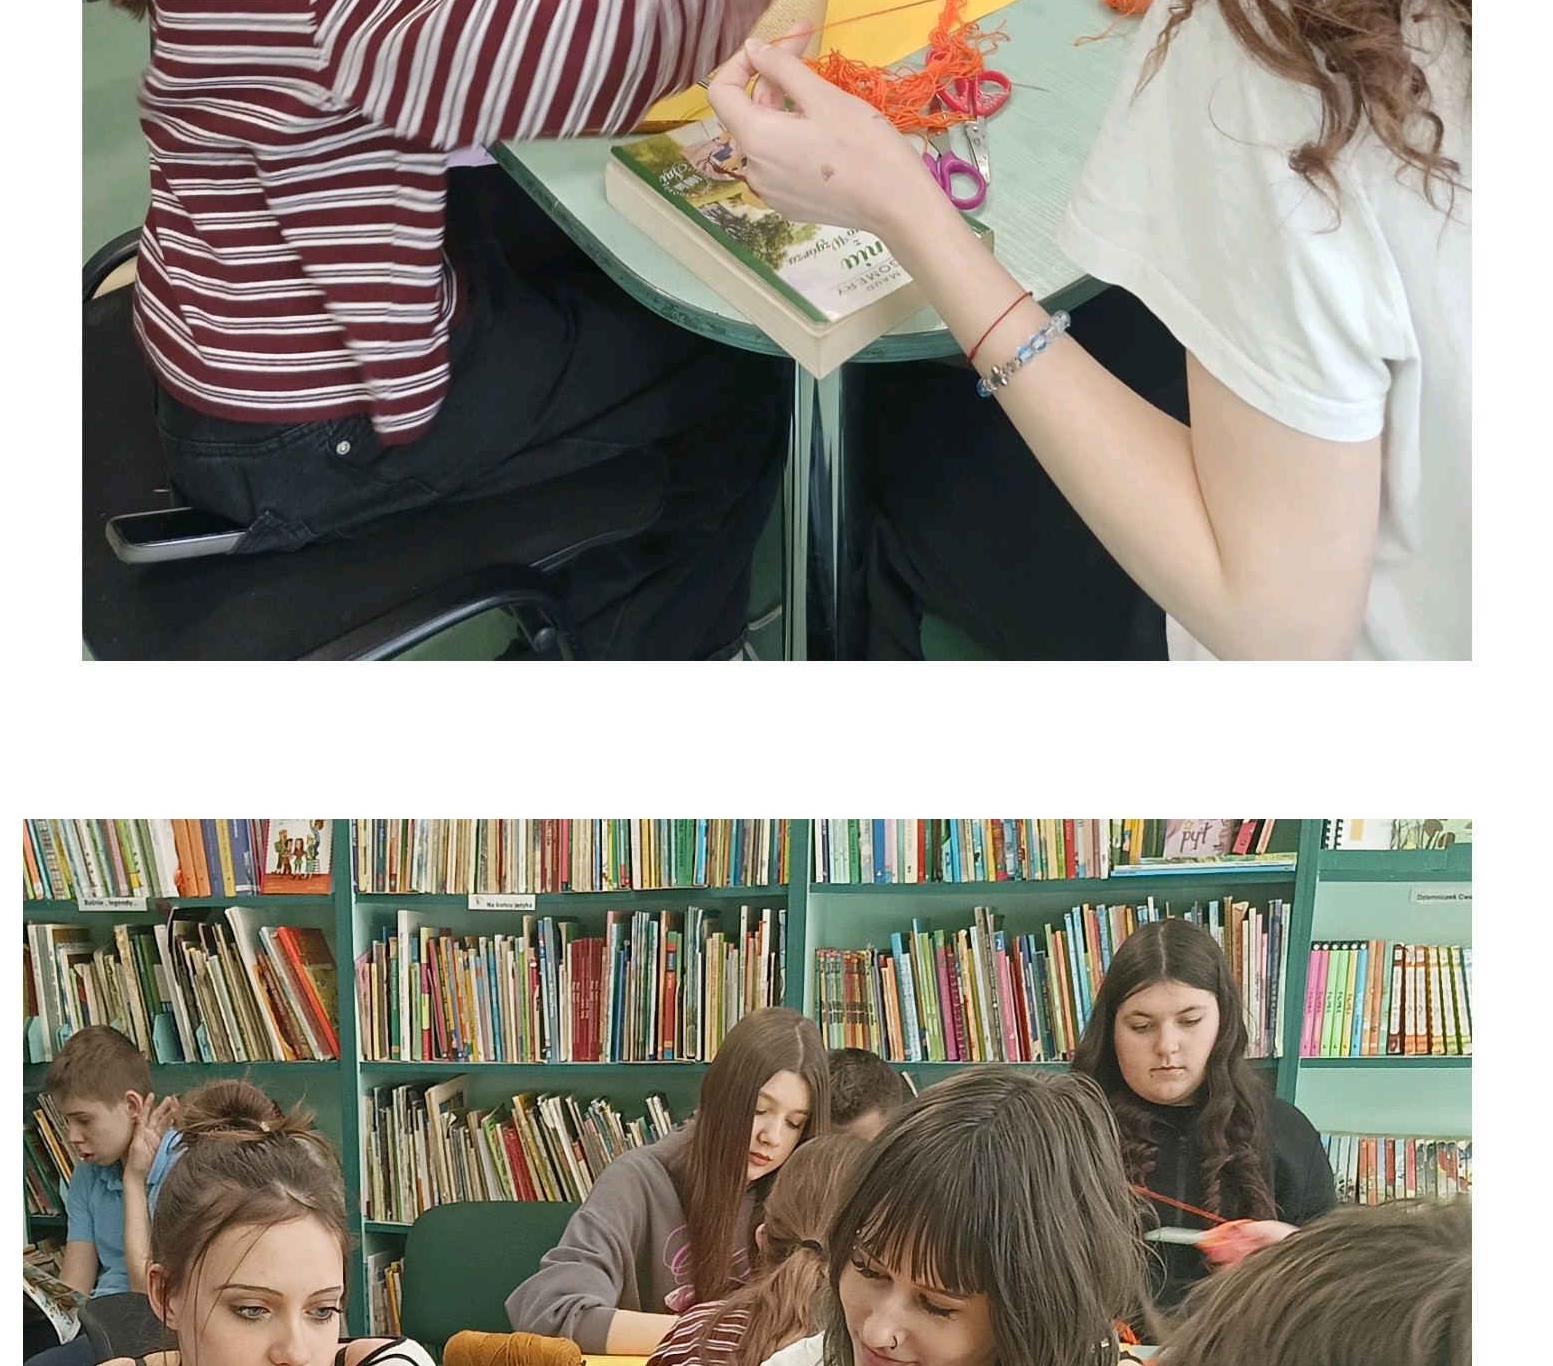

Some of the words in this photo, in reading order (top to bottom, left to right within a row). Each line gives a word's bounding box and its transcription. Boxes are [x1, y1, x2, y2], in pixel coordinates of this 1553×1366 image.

[841, 240, 885, 271] nia
[837, 258, 900, 297] GOMERY
[866, 271, 903, 293] MAUD
[1180, 821, 1212, 853] pyt
[1416, 893, 1457, 901] Dzienniczek
[995, 938, 1003, 951] 2
